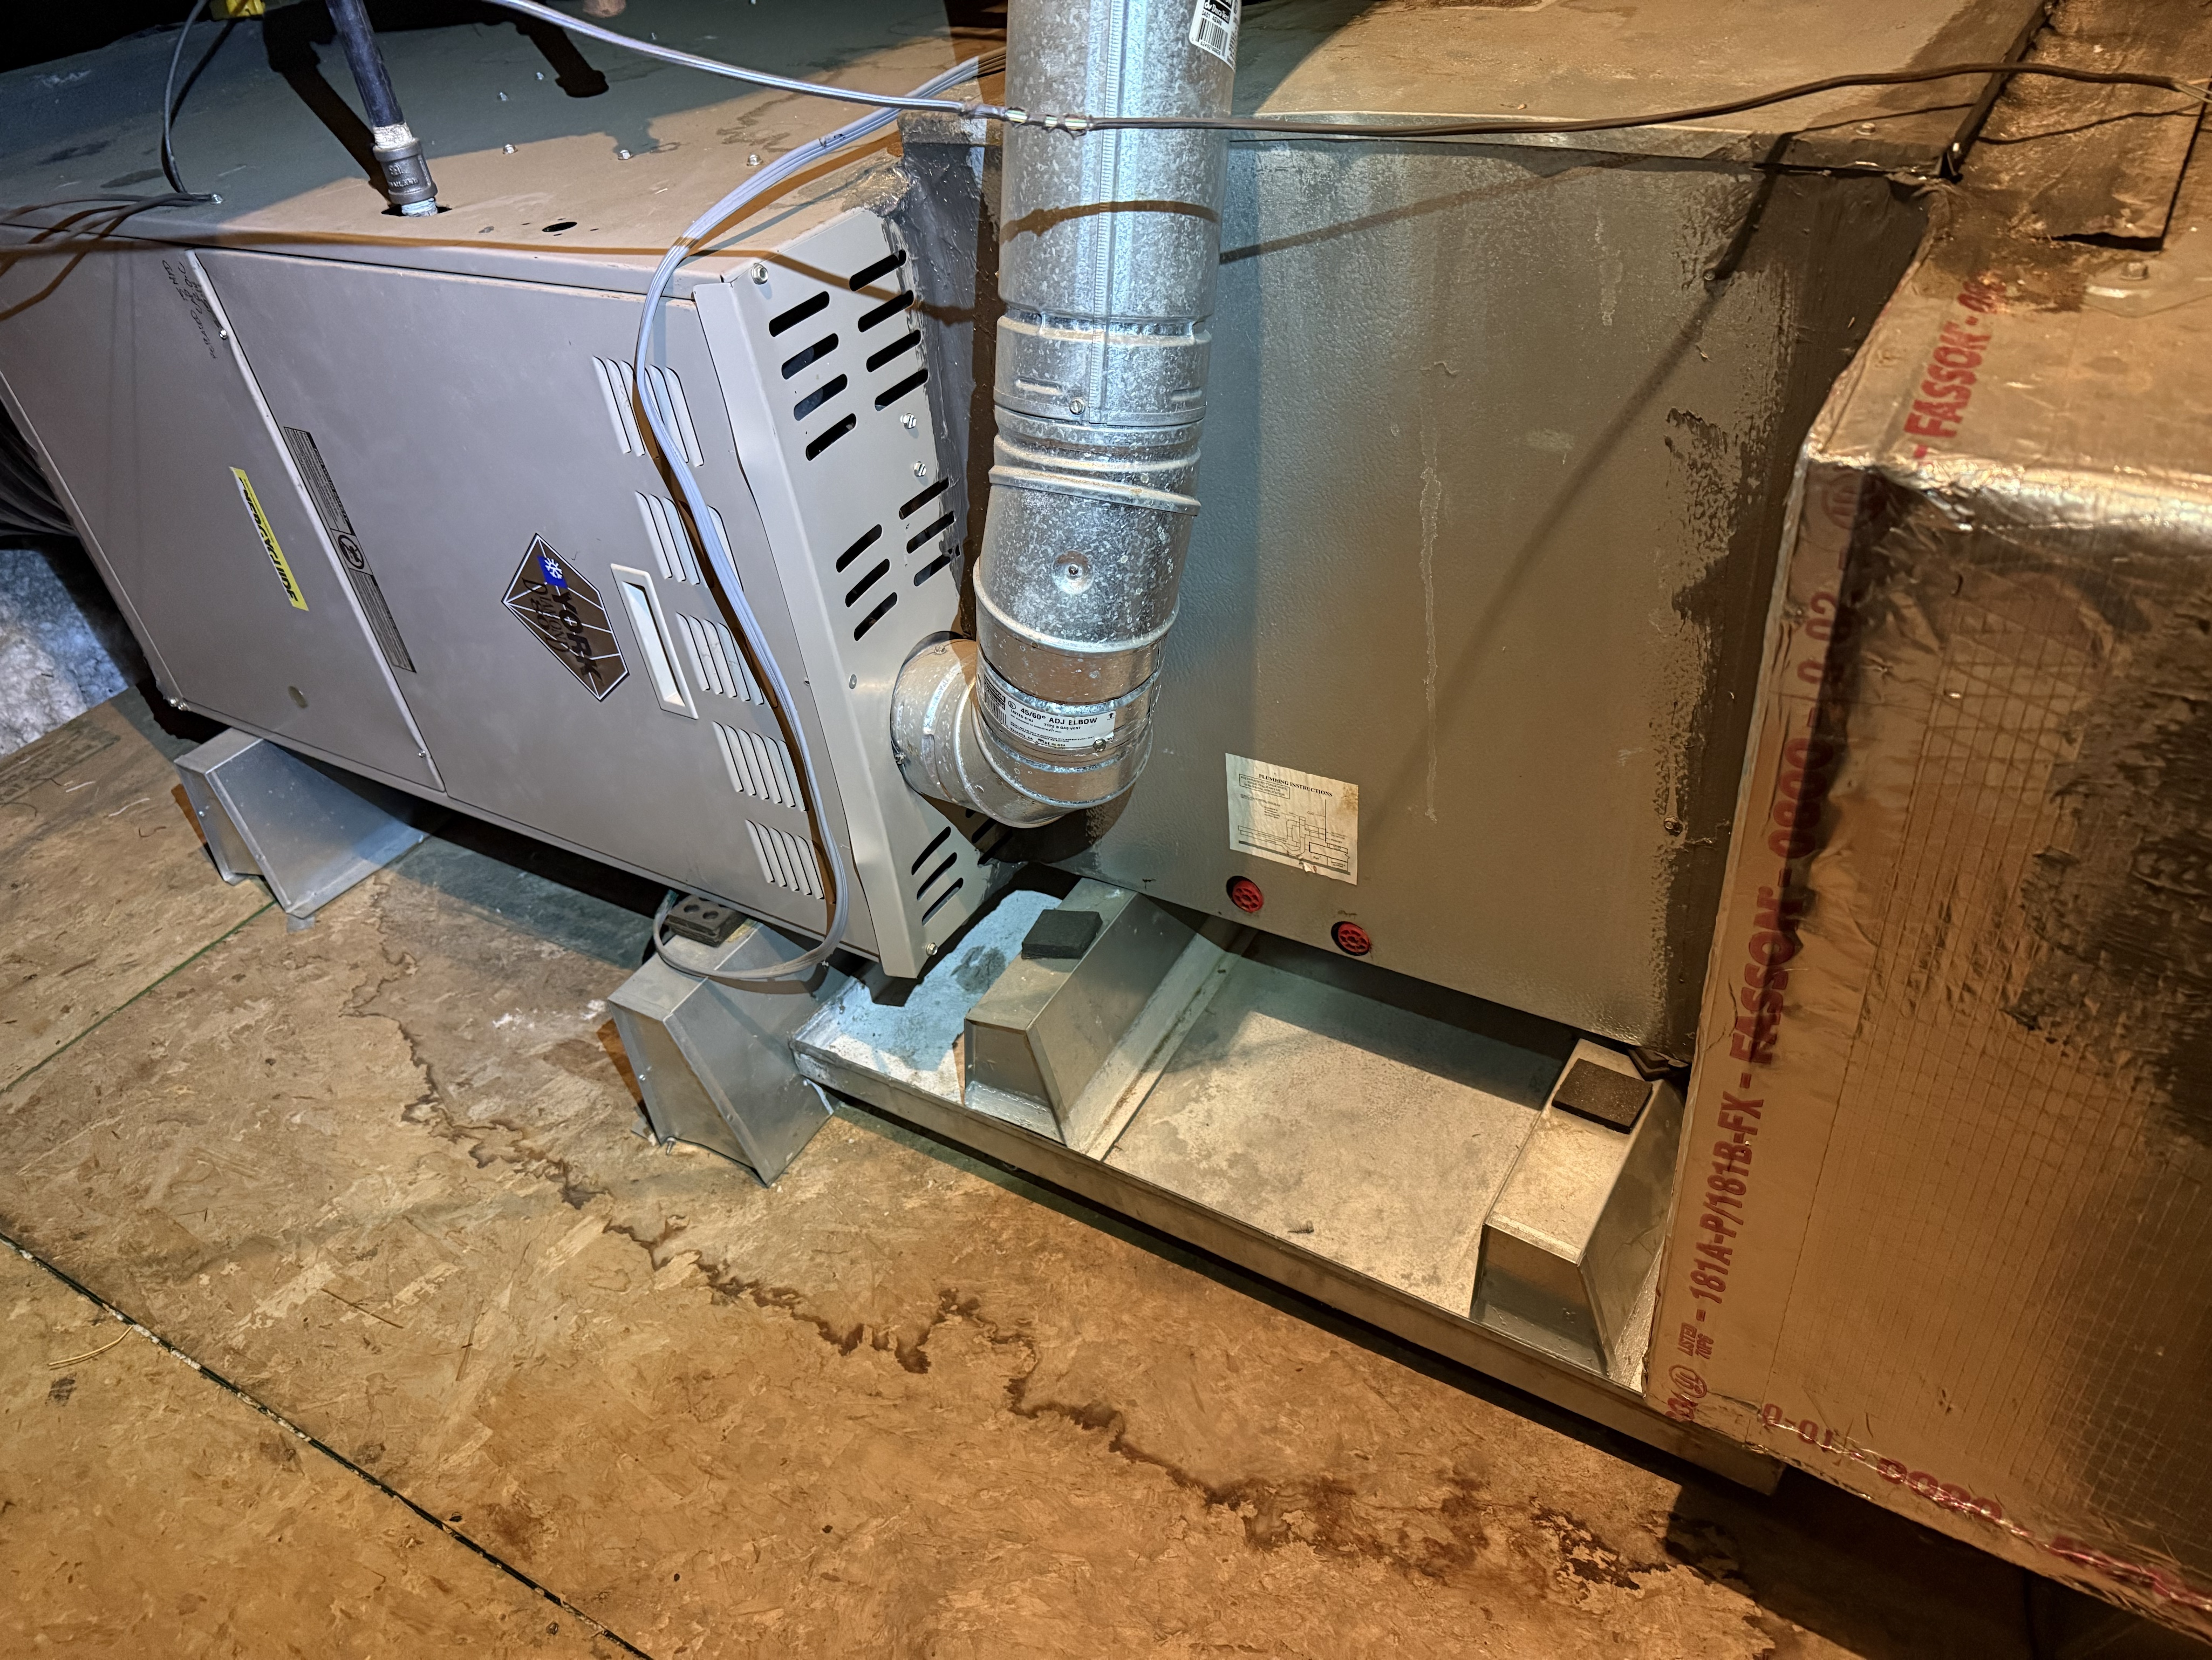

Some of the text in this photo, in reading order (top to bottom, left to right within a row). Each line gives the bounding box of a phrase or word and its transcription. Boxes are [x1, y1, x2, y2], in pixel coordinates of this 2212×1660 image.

[239, 477, 298, 602] NERGYGUIDE
[522, 577, 570, 652] DIAMOND
[530, 598, 549, 630] 80
[552, 591, 604, 686] YORK
[1068, 717, 1097, 725] ELBOW
[1259, 774, 1289, 786] PLUMBING
[1290, 783, 1333, 797] INSTRUCTIONS
